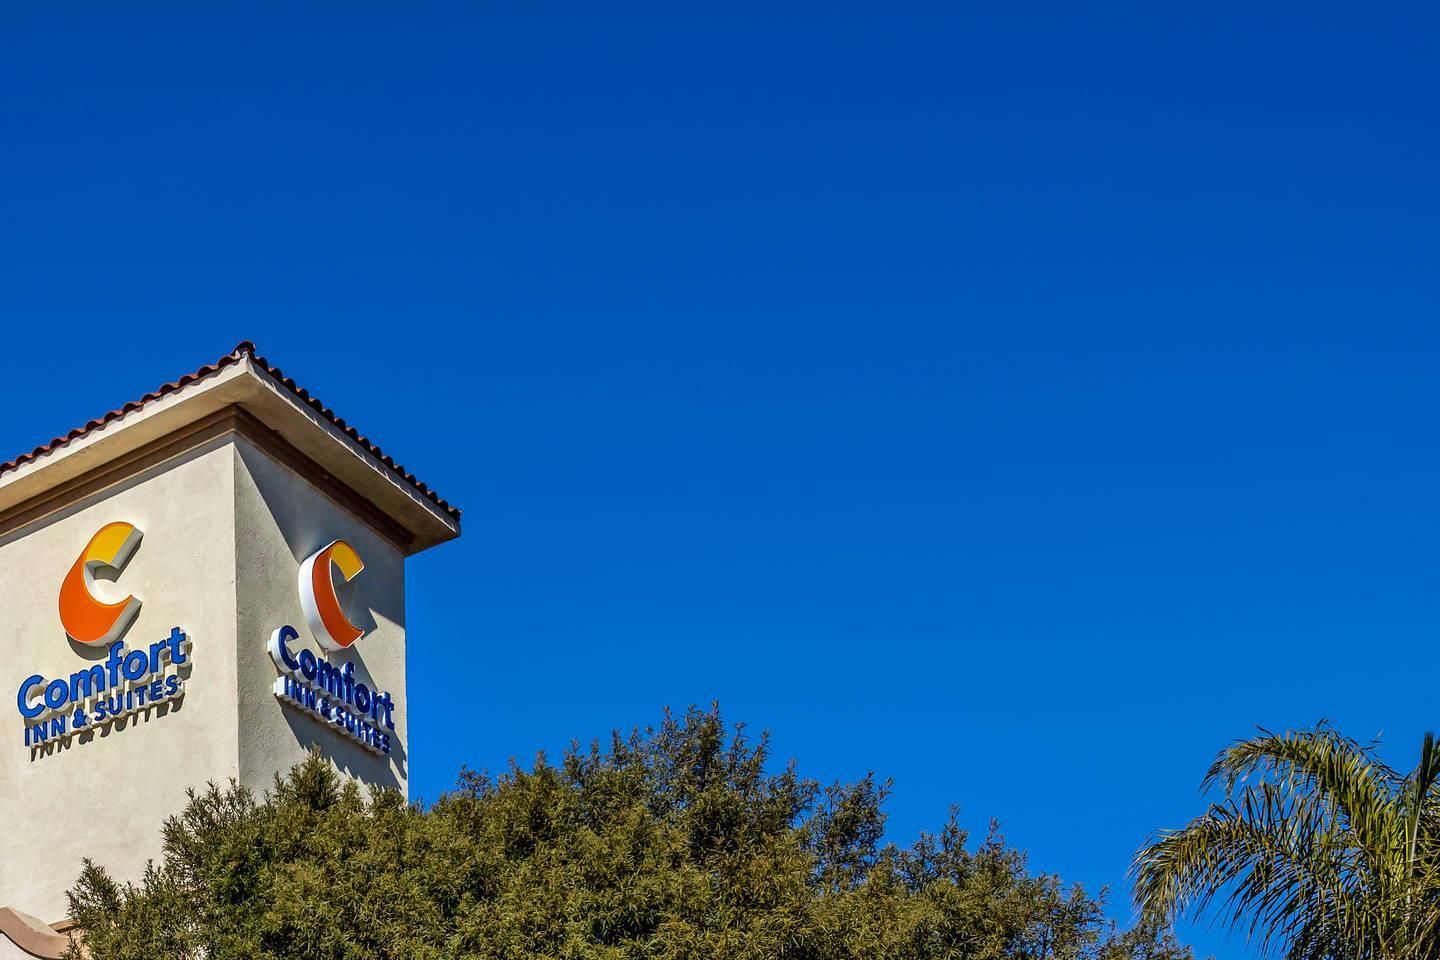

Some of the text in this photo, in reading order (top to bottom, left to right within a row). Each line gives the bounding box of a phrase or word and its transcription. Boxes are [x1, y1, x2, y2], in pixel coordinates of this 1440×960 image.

[17, 626, 188, 719] Comfort
[25, 674, 180, 747] INN & SUITES
[275, 625, 395, 731] Comfort
[277, 675, 316, 711] INN
[331, 706, 391, 754] SUITES
